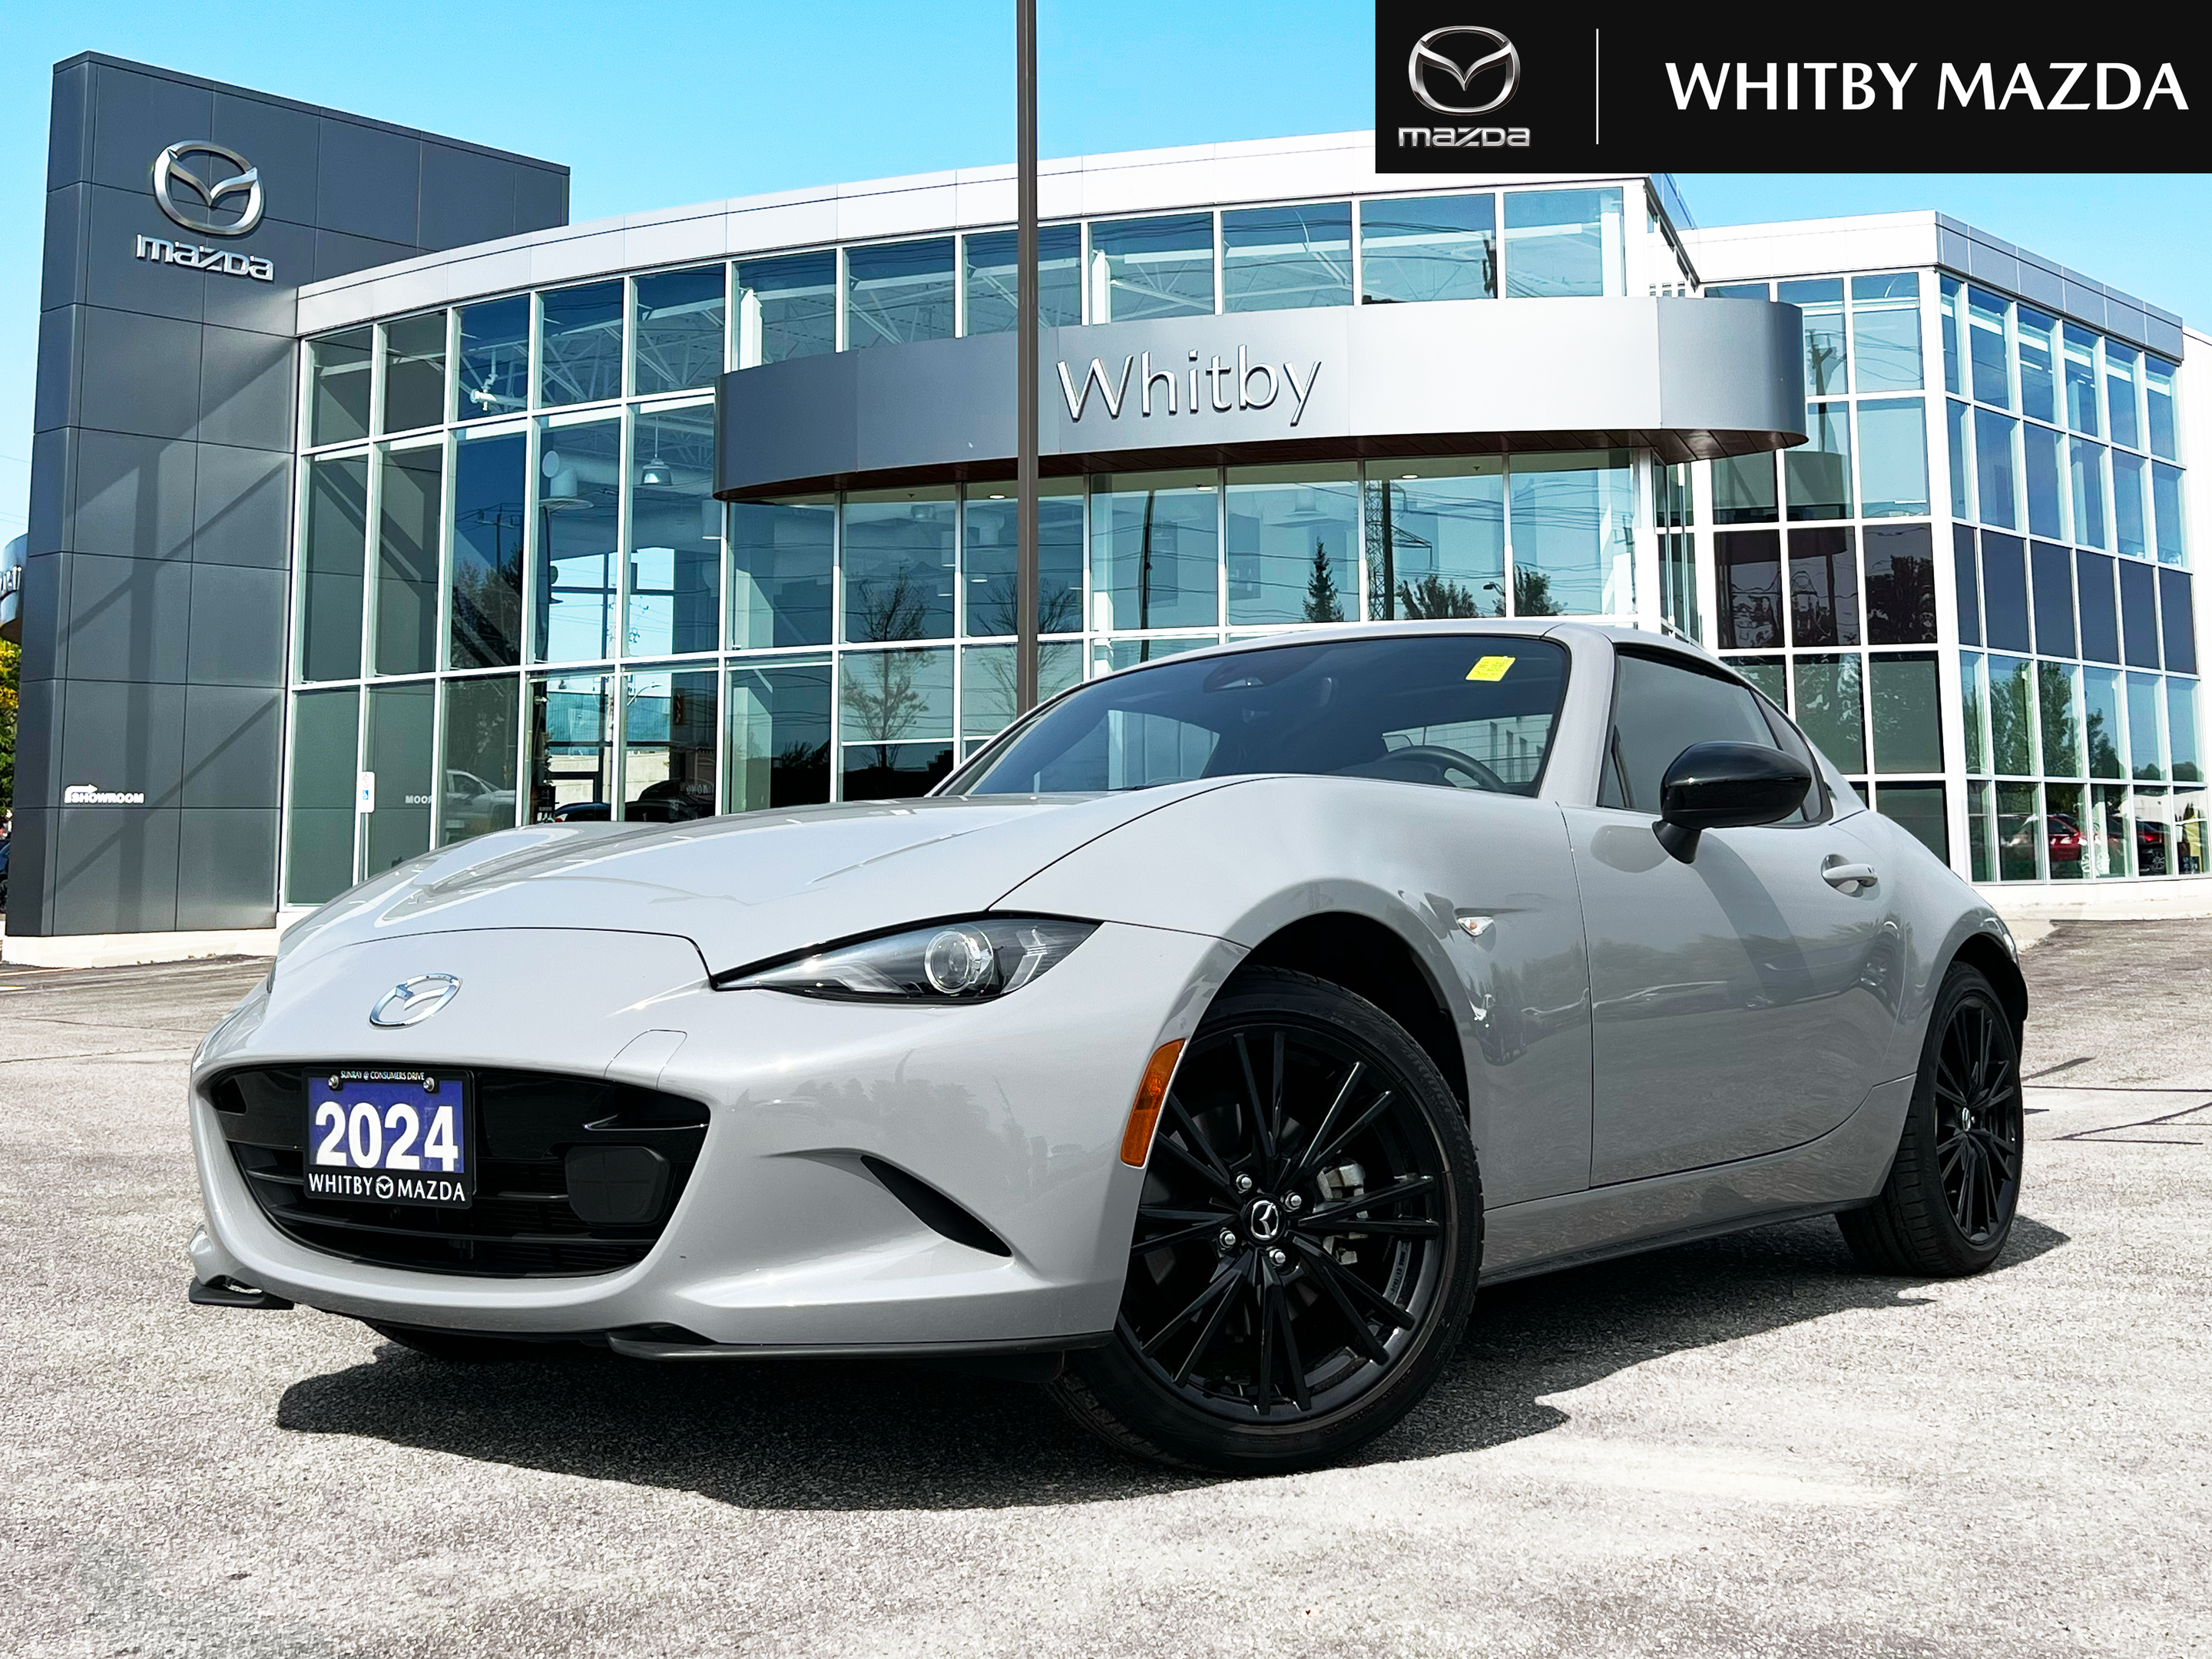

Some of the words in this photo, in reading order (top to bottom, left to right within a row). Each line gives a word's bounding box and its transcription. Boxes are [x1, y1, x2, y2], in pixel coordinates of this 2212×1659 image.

[136, 234, 273, 281] mazda
[1057, 343, 1322, 427] Whitby
[71, 792, 144, 803] SHOWROOM
[340, 1071, 363, 1079] SUNRAY
[370, 1071, 406, 1080] CONSUMERS
[316, 1101, 459, 1171] 2024
[308, 1173, 373, 1196] WHITBY
[397, 1178, 465, 1202] MAZDA
